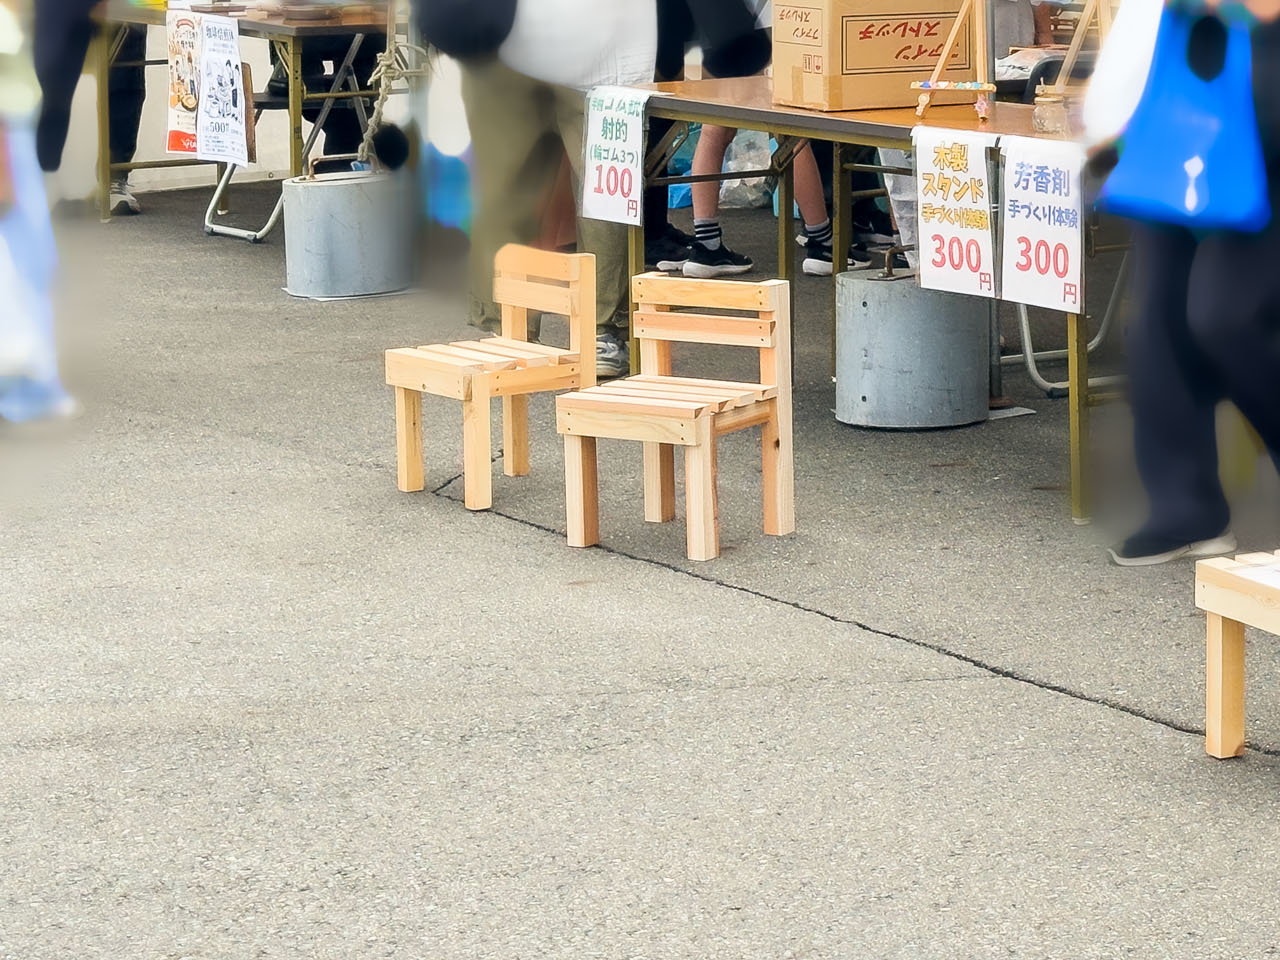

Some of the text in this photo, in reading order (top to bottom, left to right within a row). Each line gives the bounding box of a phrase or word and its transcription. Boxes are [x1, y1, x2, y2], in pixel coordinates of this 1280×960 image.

[858, 20, 941, 41] ストレッチ
[601, 116, 628, 143] 射的
[933, 142, 969, 173] 木製
[922, 172, 985, 203] スタンド
[1014, 161, 1070, 197] 芳香剤
[1008, 199, 1078, 229] 手づくり体験
